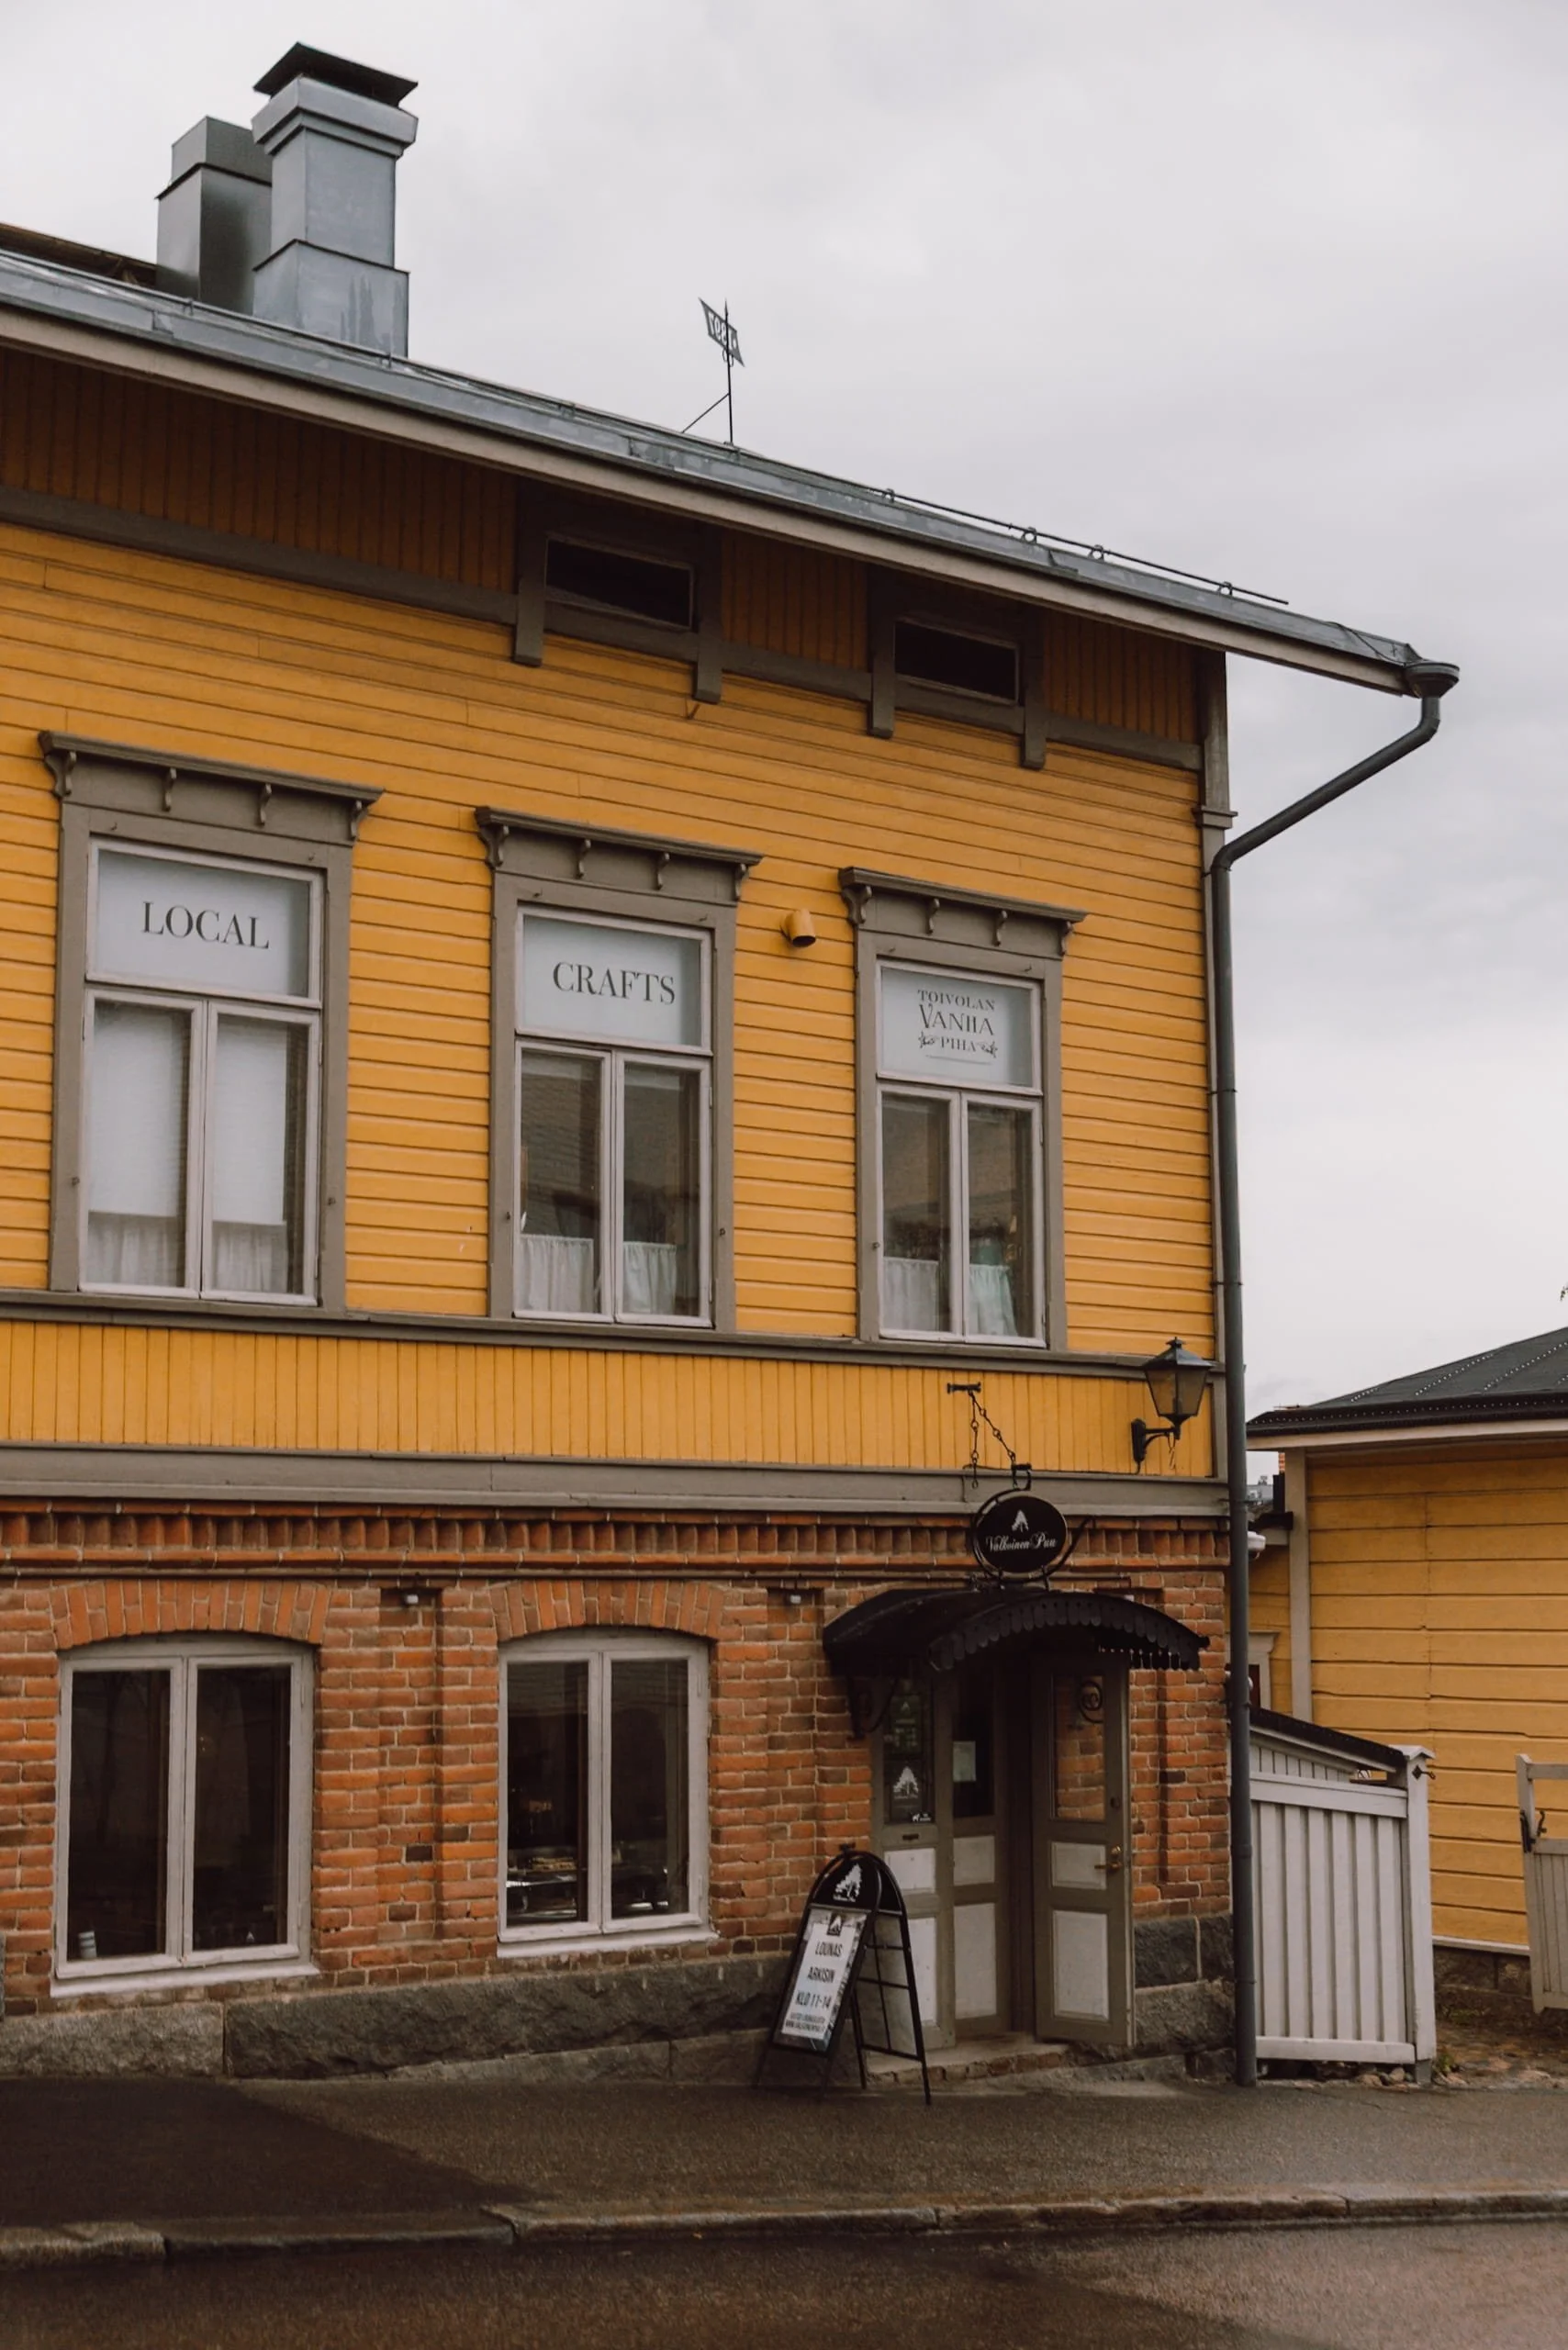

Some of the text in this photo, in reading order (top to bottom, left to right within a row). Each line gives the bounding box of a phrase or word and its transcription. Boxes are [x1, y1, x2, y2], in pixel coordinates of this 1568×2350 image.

[141, 900, 269, 950] LOCAL
[552, 960, 676, 1005] CRAFTS
[918, 990, 995, 1011] TOIVOLAN
[919, 1003, 994, 1035] VANHA
[985, 1535, 1030, 1551] Valkoinen
[815, 1942, 842, 1957] LOUNAS
[811, 1994, 832, 2009] 11-14
